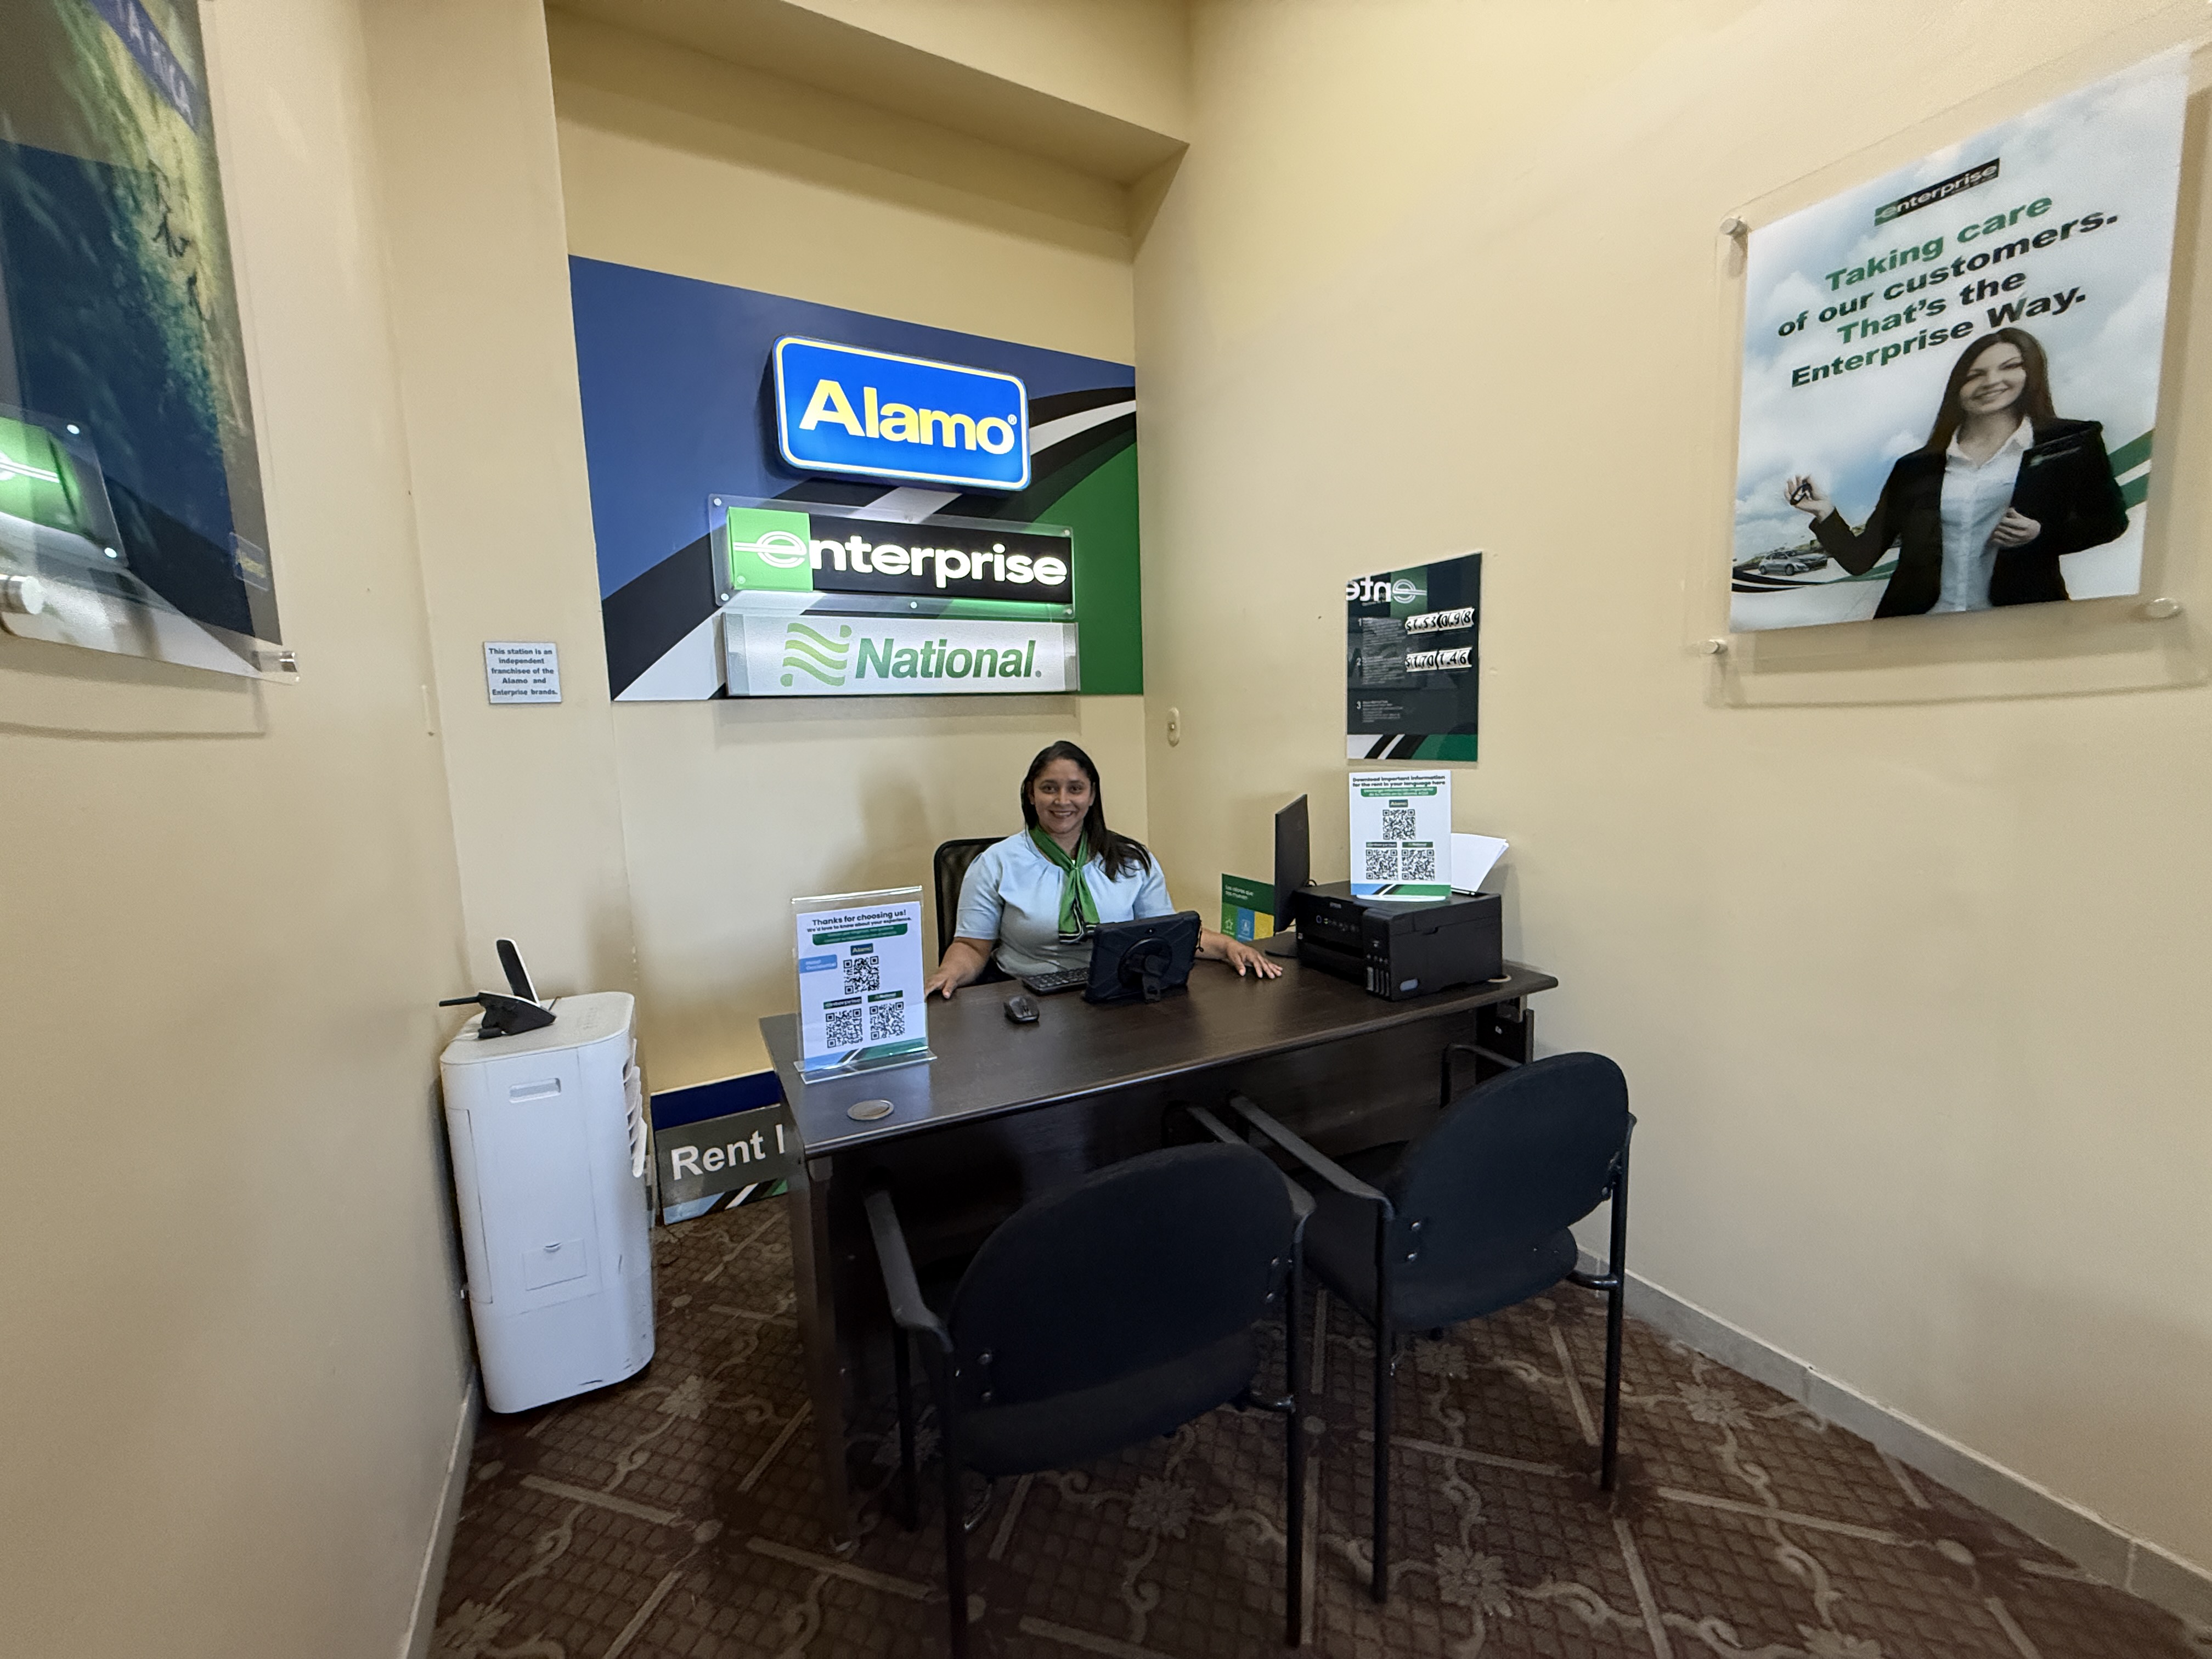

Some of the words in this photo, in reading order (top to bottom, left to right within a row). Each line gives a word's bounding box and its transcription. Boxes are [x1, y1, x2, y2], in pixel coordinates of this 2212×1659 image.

[1875, 165, 1997, 218] enterprise
[1777, 312, 1808, 338] of
[1818, 291, 1872, 324] our
[1883, 211, 2119, 303] customers.
[1825, 235, 1945, 292] Taking
[1956, 196, 2053, 245] care
[1791, 320, 1974, 387] Enterprise
[1987, 285, 2086, 329] Way.
[1837, 298, 1947, 345] That's
[1959, 272, 2027, 307] the
[799, 379, 1015, 455] Alamo
[734, 531, 1068, 589] enterprise
[855, 637, 1037, 679] National
[812, 917, 843, 926] Thanks
[857, 911, 893, 921] choosing
[894, 909, 906, 918] us!
[670, 1130, 766, 1181] Rent
